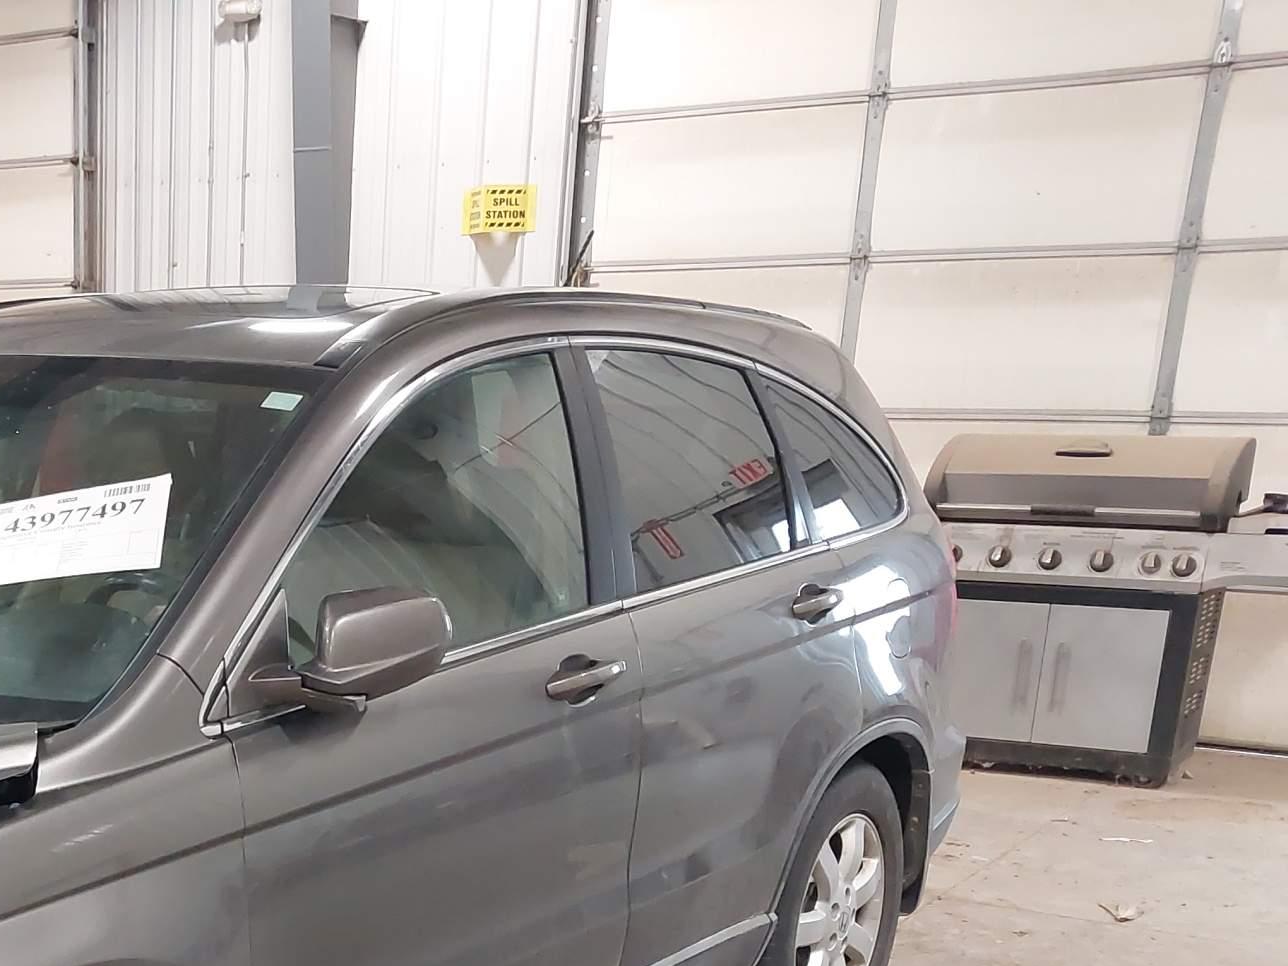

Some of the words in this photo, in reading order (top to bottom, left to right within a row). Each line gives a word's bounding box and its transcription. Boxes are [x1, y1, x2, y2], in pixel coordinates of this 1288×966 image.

[493, 198, 520, 207] SPILL
[485, 210, 526, 219] STATION
[4, 498, 146, 533] 43977497
